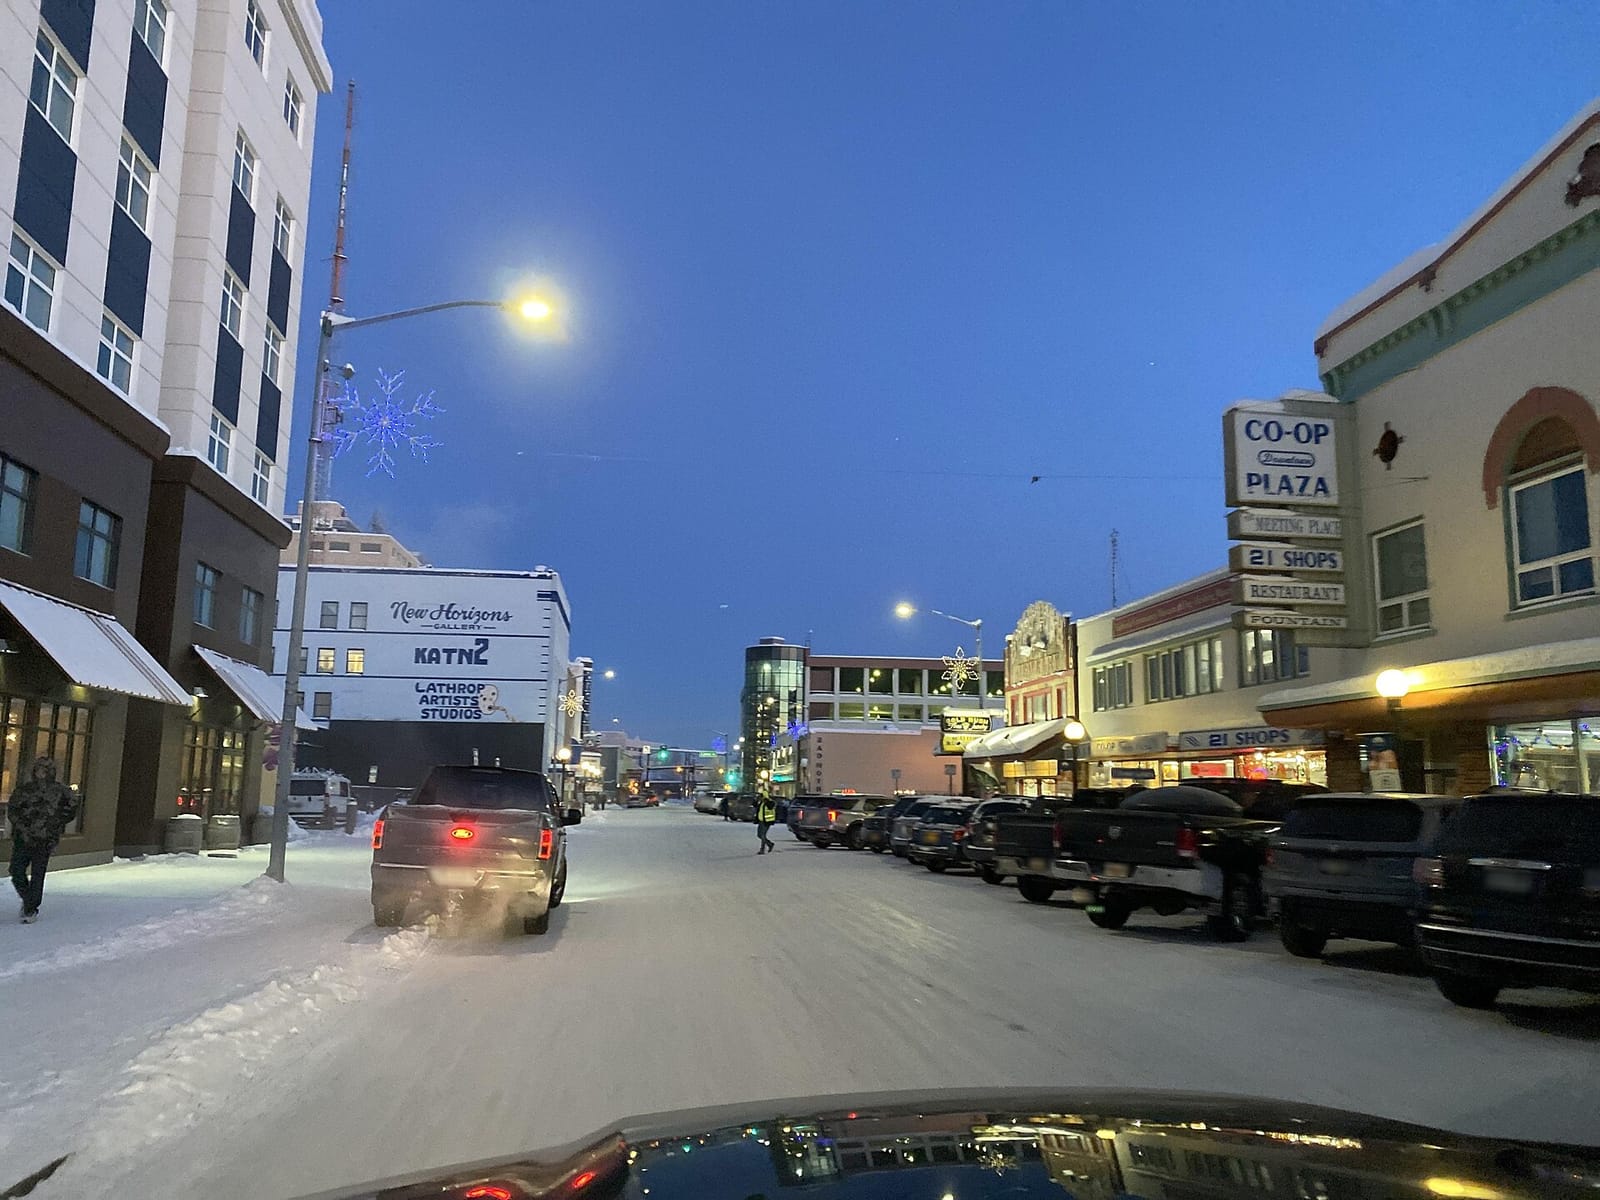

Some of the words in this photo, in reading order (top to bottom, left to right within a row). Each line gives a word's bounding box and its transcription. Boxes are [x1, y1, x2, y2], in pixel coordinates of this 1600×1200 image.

[1245, 420, 1329, 444] CO-OP
[1247, 473, 1330, 497] PLAZA
[1250, 550, 1272, 566] 21
[1284, 551, 1338, 569] SHOPS
[1251, 585, 1340, 601] RESTAURANT
[390, 601, 429, 623] New
[430, 603, 512, 624] Horizons
[1251, 615, 1342, 626] FOUNTAIN
[415, 682, 485, 694] LATHROP
[419, 695, 479, 706] ARTISTS
[421, 708, 482, 719] STUDIOS
[1209, 733, 1228, 746] 21
[1235, 729, 1290, 745] SHOPS
